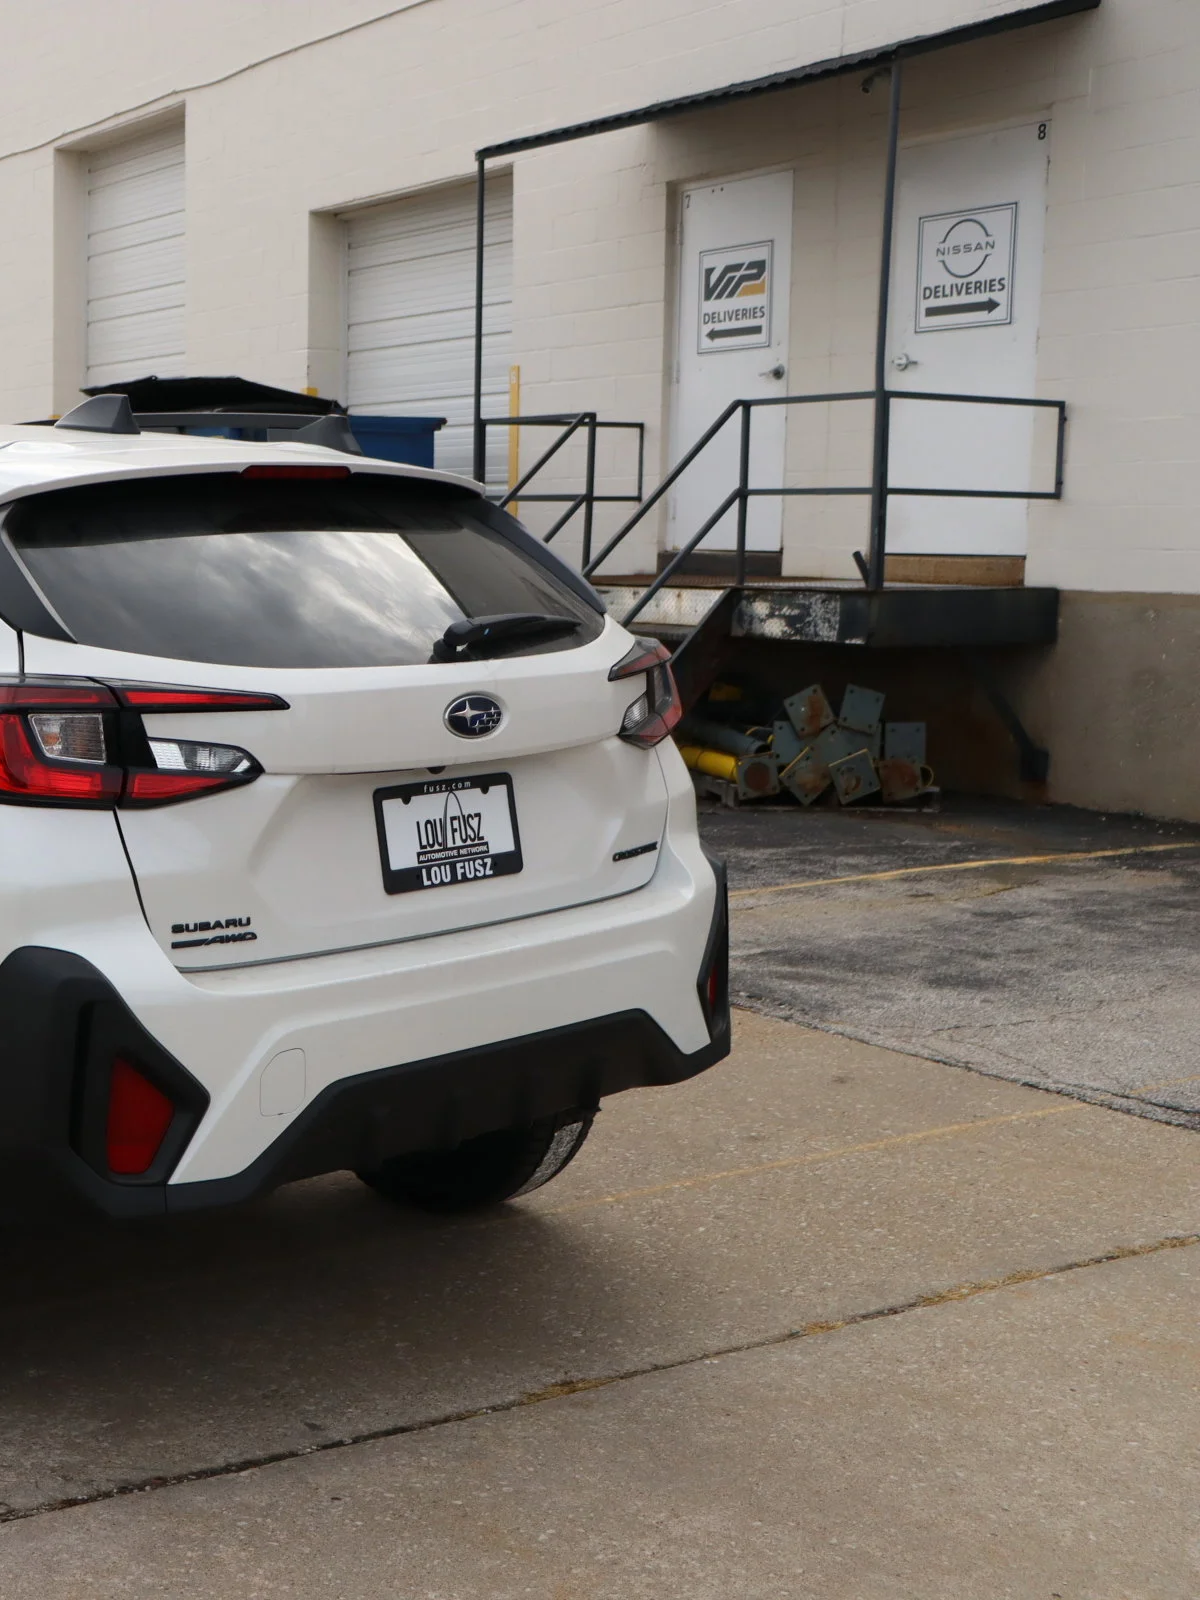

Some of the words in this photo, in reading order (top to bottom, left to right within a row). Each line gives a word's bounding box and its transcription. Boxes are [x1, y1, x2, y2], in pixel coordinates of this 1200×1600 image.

[1037, 123, 1047, 141] 8
[936, 240, 996, 257] NISSAN
[704, 259, 767, 301] VIP
[922, 277, 1006, 300] DELIVERIES
[703, 306, 765, 325] DELIVERIES
[424, 781, 471, 793] fusz.com
[416, 818, 443, 850] LOU
[450, 812, 485, 845] FUSZ
[419, 850, 458, 861] AUTOMOTIVE
[459, 845, 488, 856] NETWORK
[422, 865, 451, 886] LOU
[456, 858, 493, 880] FUSZ
[171, 916, 251, 934] SUBARU
[204, 932, 257, 945] AWD
